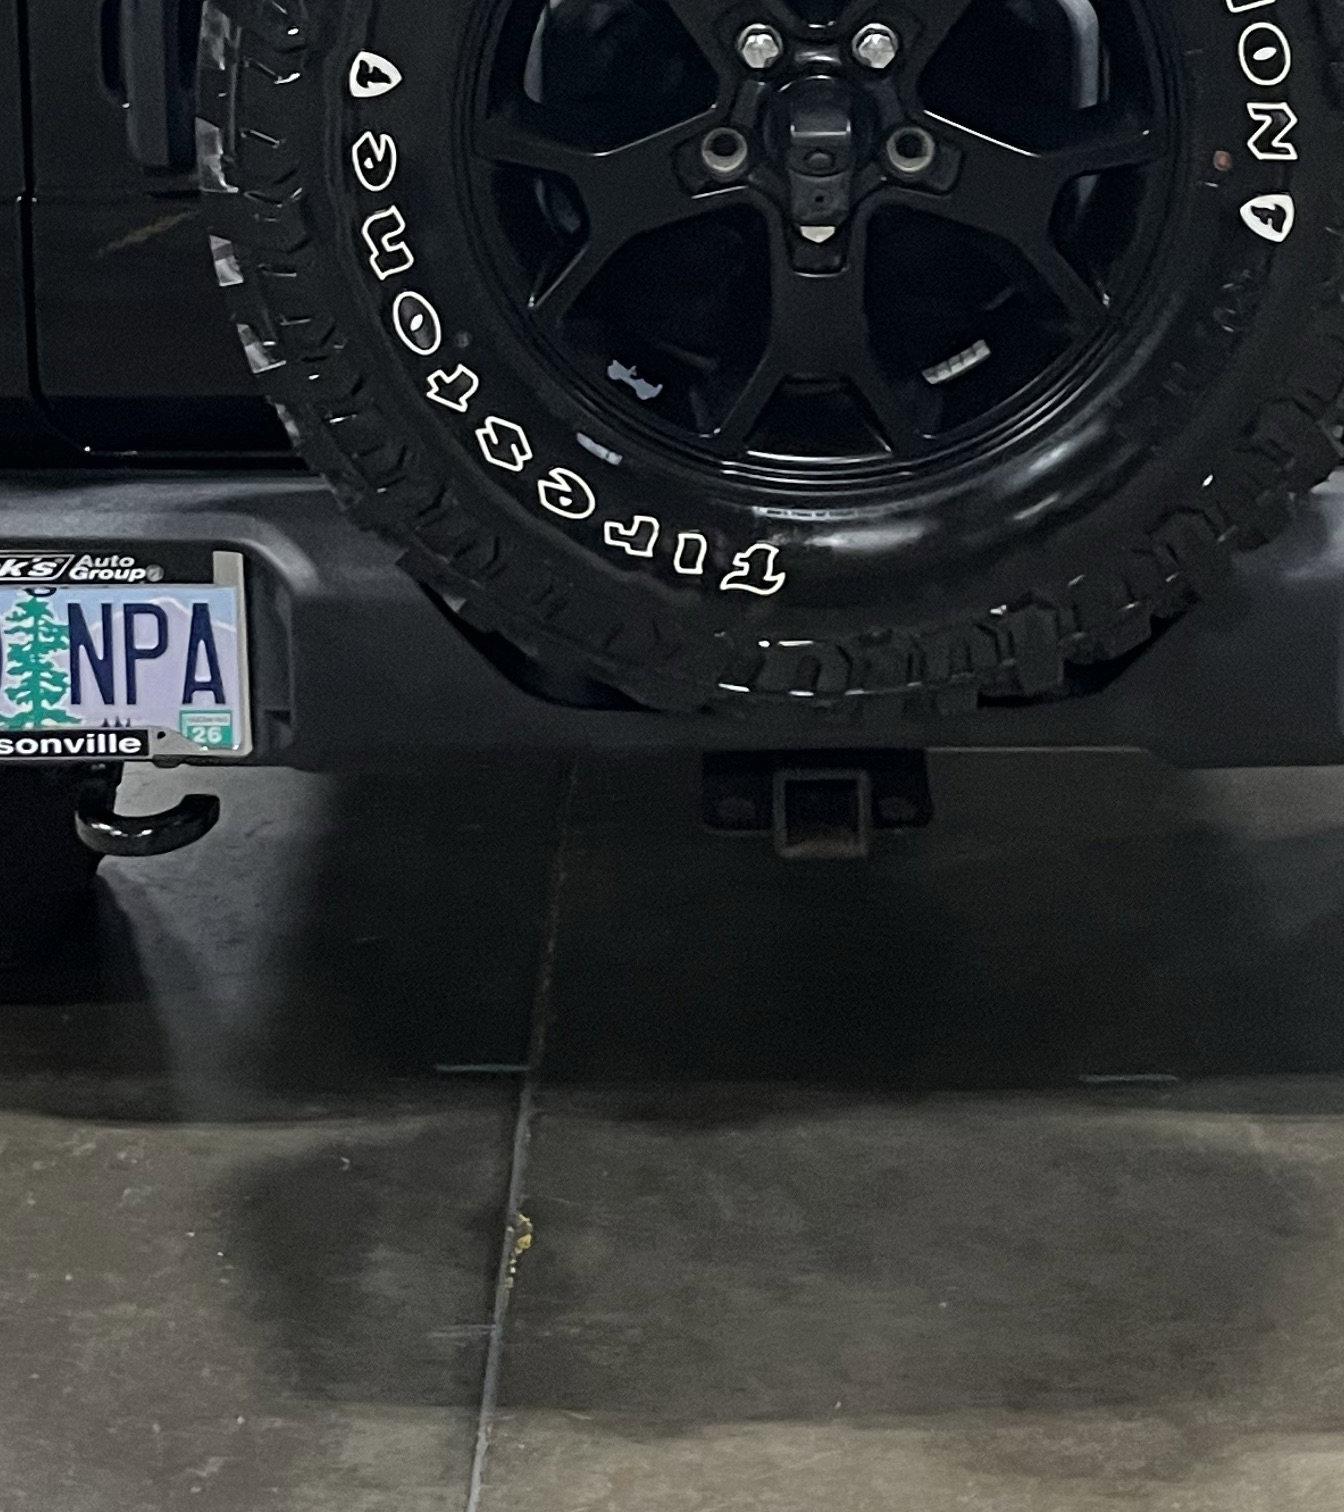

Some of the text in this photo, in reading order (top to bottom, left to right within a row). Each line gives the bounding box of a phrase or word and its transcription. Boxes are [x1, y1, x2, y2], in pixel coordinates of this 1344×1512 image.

[351, 131, 786, 596] Firestone
[77, 555, 135, 568] Auto
[69, 566, 146, 583] Group
[68, 602, 227, 705] NPA
[191, 726, 223, 745] 26
